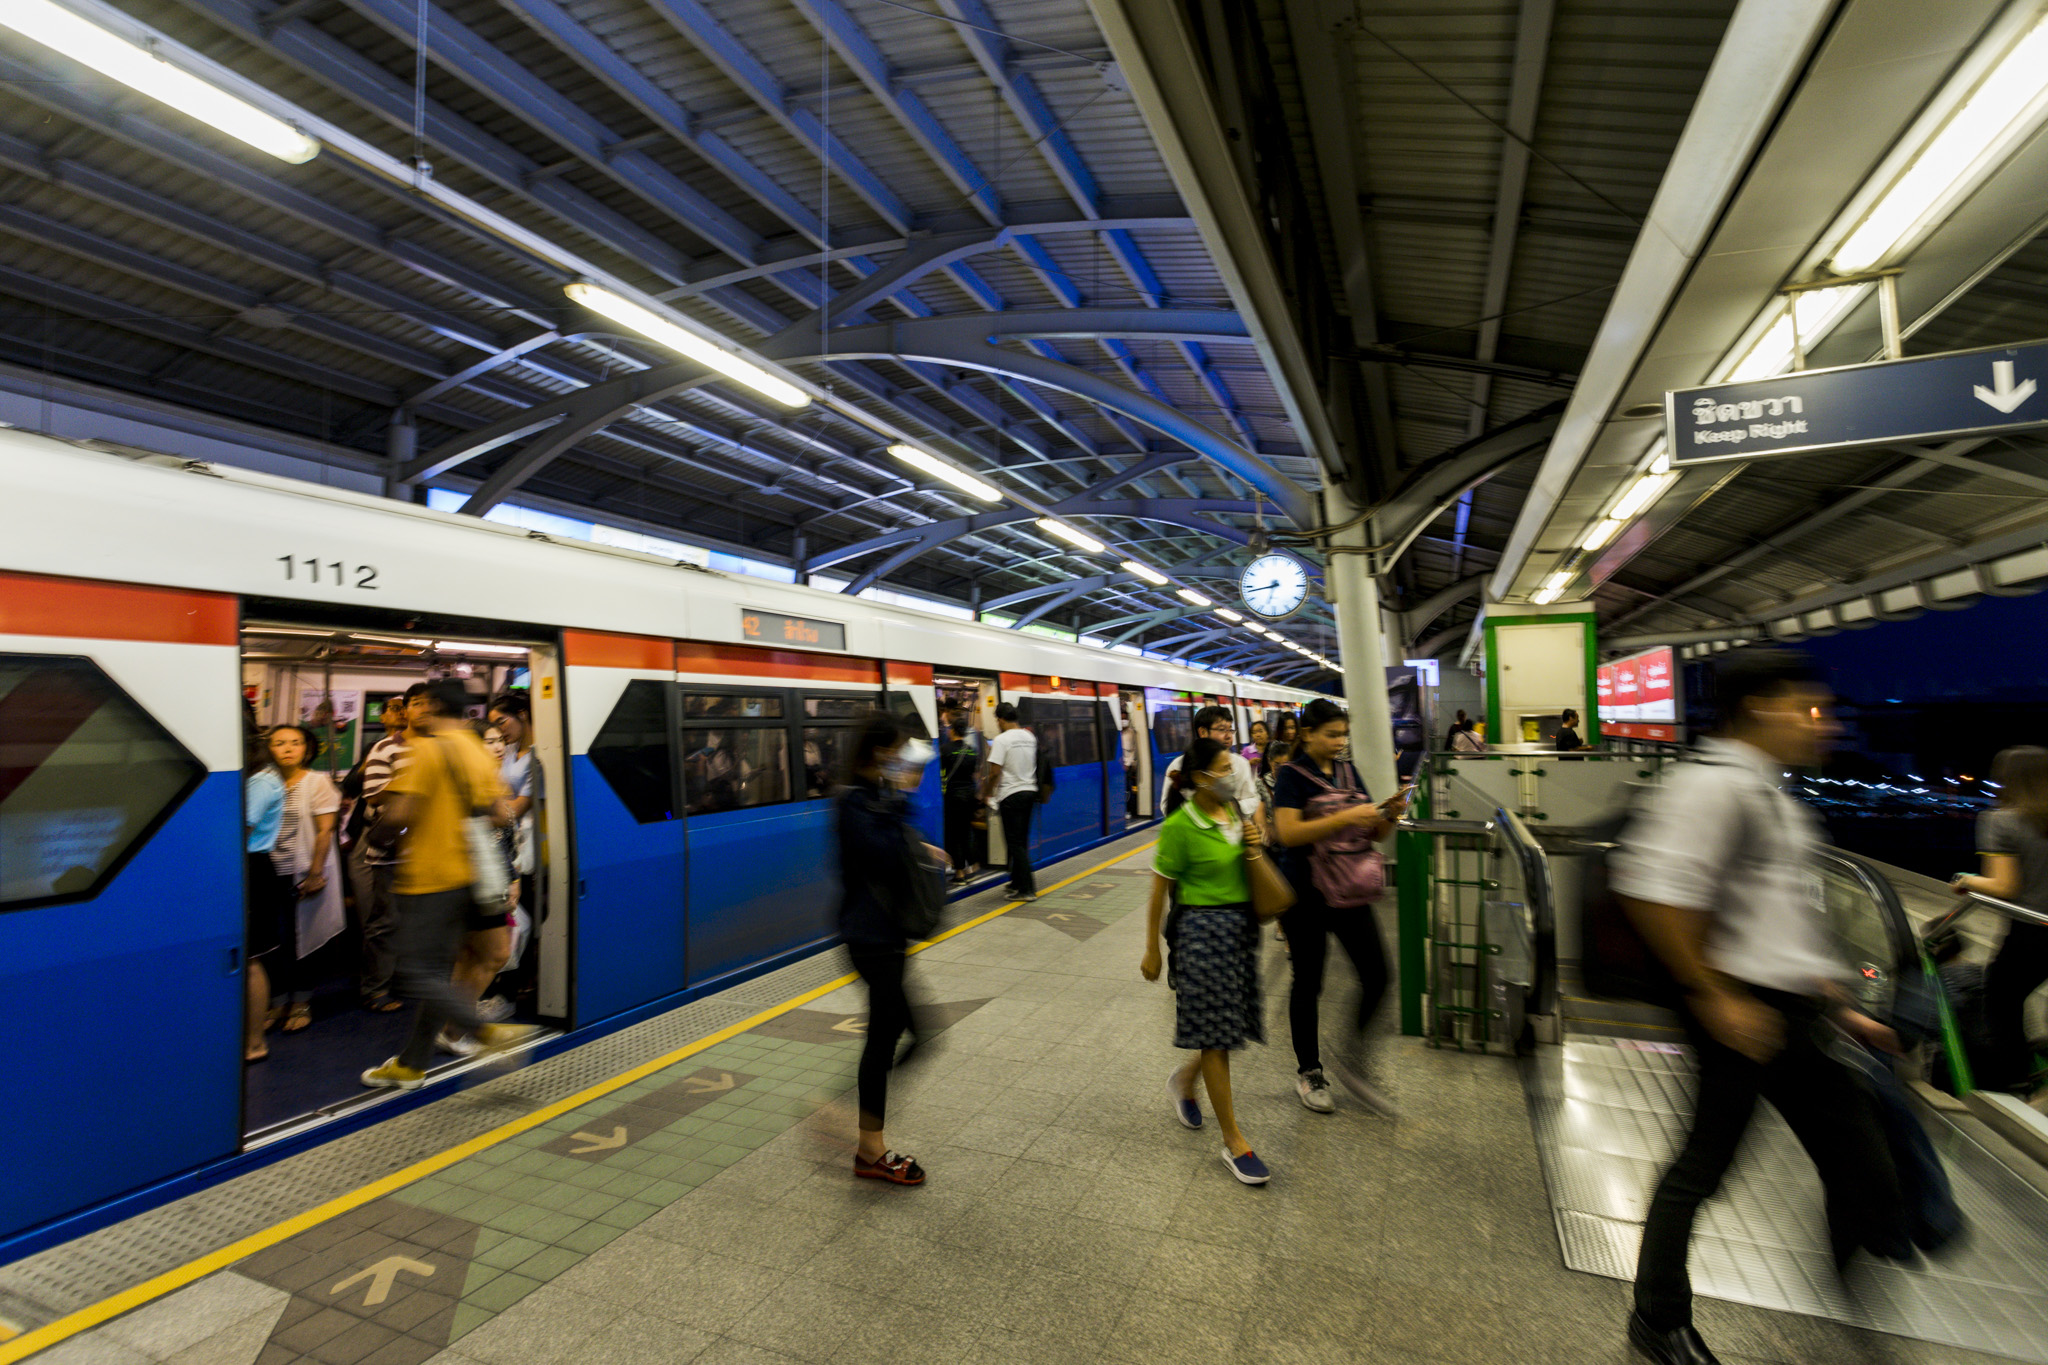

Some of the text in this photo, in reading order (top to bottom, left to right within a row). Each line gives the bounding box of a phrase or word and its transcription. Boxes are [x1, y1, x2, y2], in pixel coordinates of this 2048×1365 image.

[1692, 396, 1803, 425] ชิดขวา
[1694, 420, 1808, 444] Keep Right
[276, 554, 380, 590] 1112
